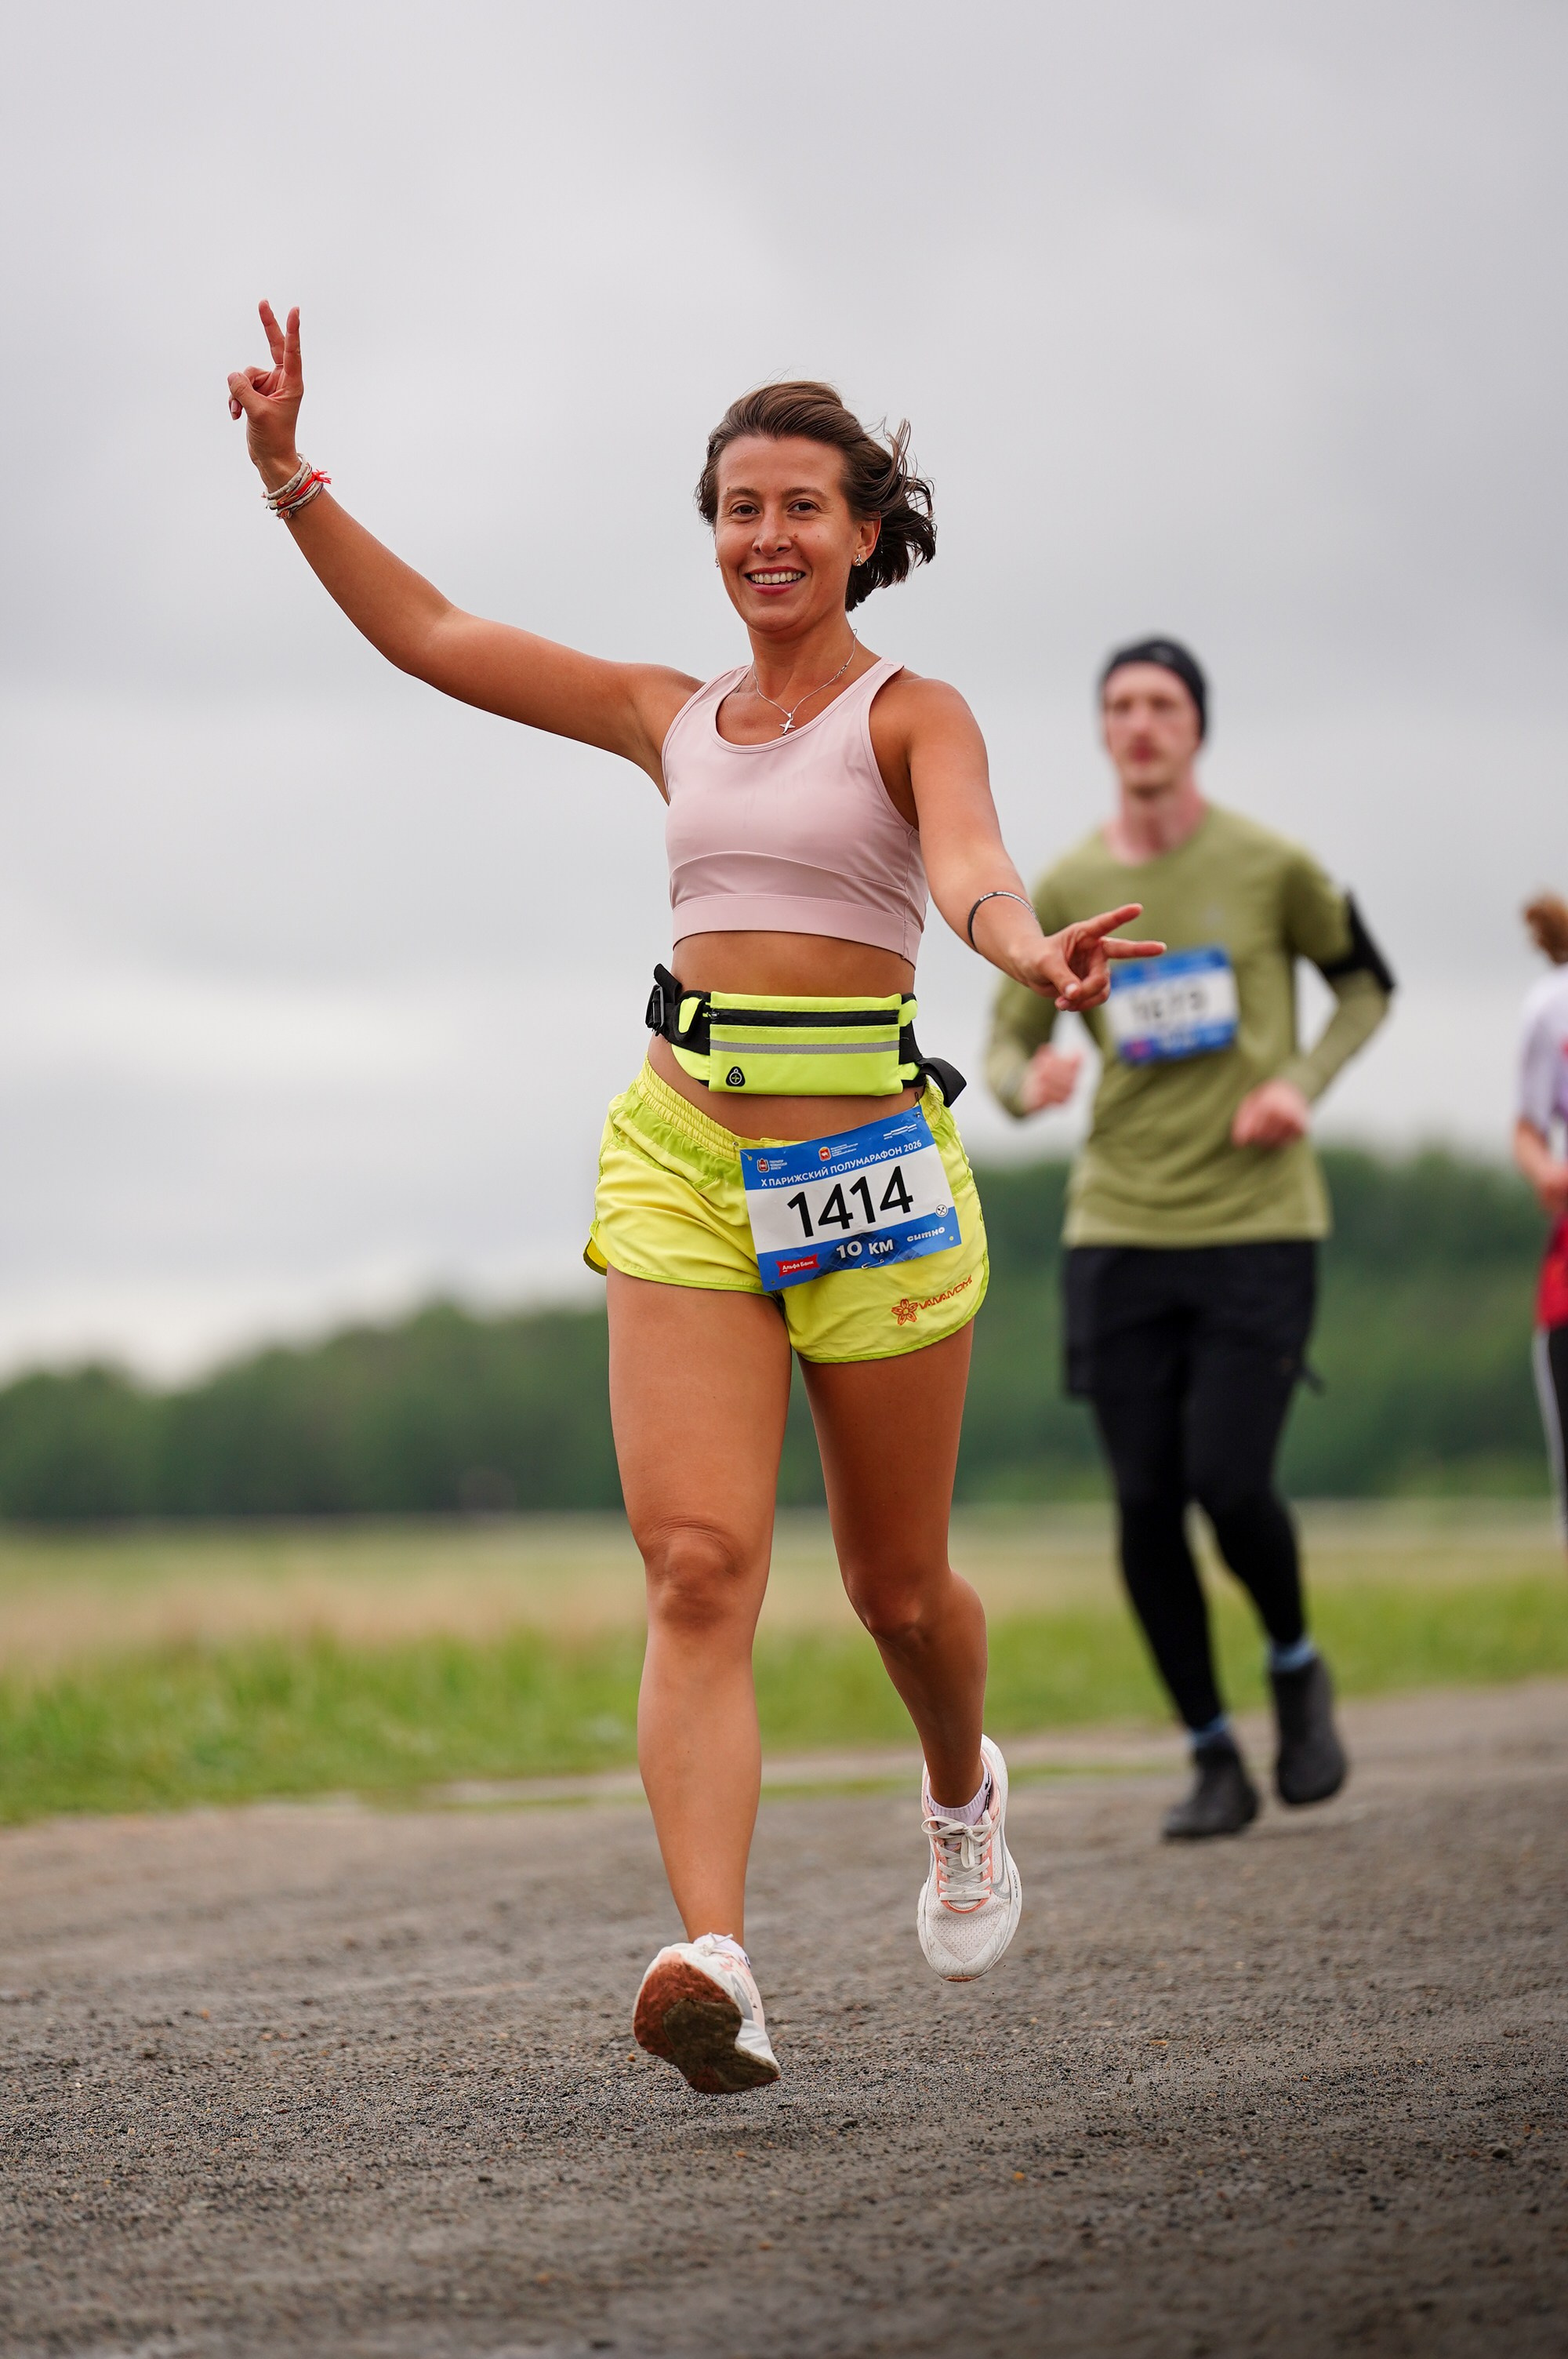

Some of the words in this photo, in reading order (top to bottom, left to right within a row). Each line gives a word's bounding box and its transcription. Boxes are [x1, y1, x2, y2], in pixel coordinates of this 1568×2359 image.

[768, 1167, 829, 1187] ПАРИЖСКИЙ
[829, 1146, 902, 1174] ПОЛУМАРАФОН
[903, 1140, 922, 1153] 2026
[787, 1165, 913, 1238] 1414
[836, 1241, 862, 1259] 10
